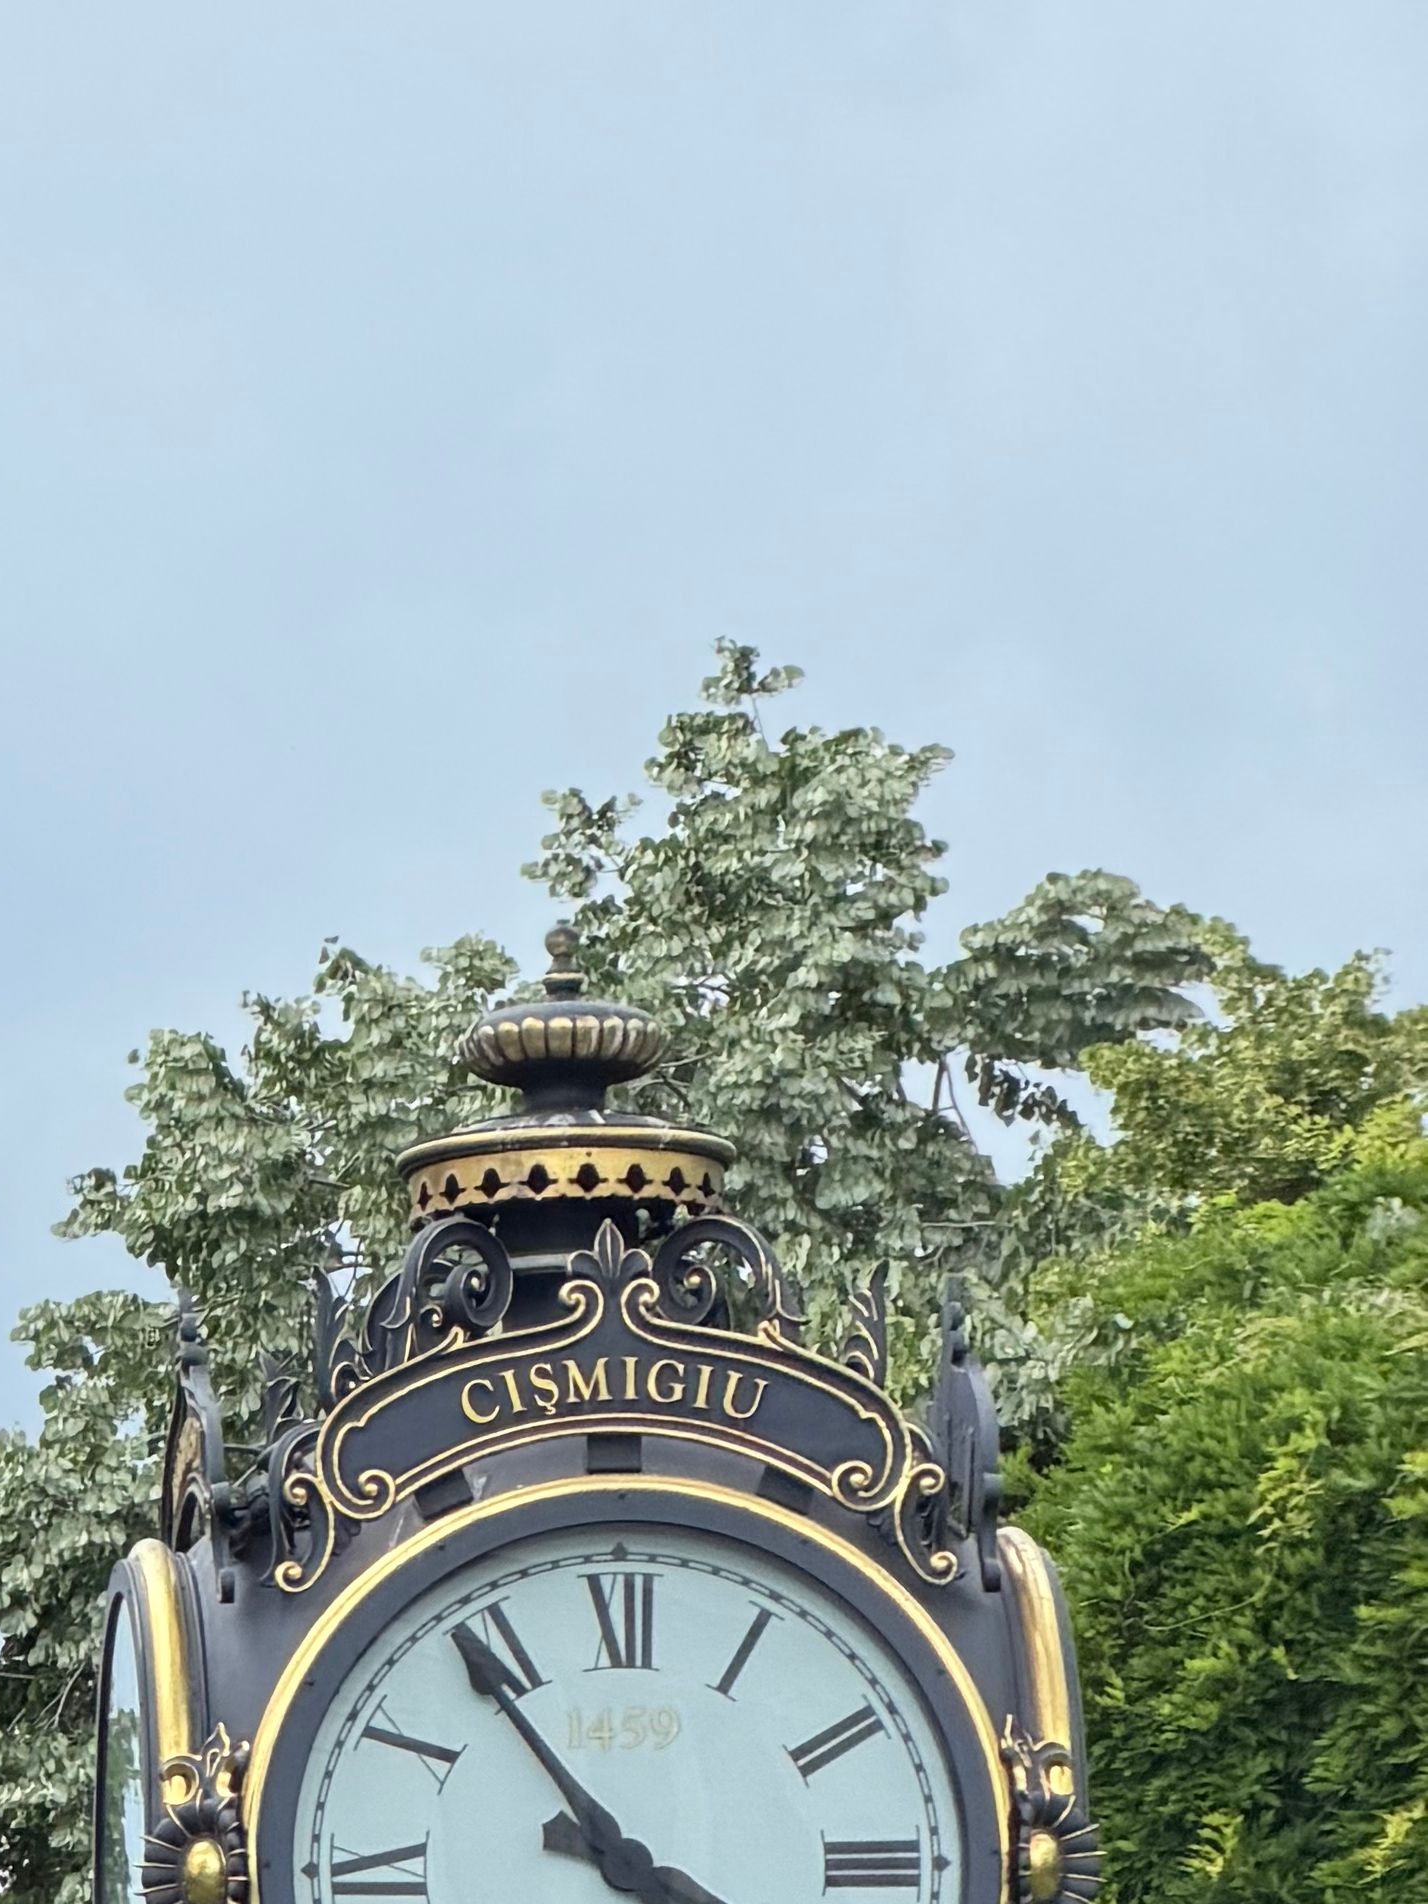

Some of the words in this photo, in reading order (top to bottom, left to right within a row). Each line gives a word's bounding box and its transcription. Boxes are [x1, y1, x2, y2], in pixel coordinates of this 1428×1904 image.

[578, 1572, 663, 1671] XII
[706, 1599, 785, 1701] I
[354, 1695, 468, 1794] X
[567, 1704, 682, 1751] 1459
[782, 1694, 890, 1787] II
[822, 1825, 920, 1901] III
